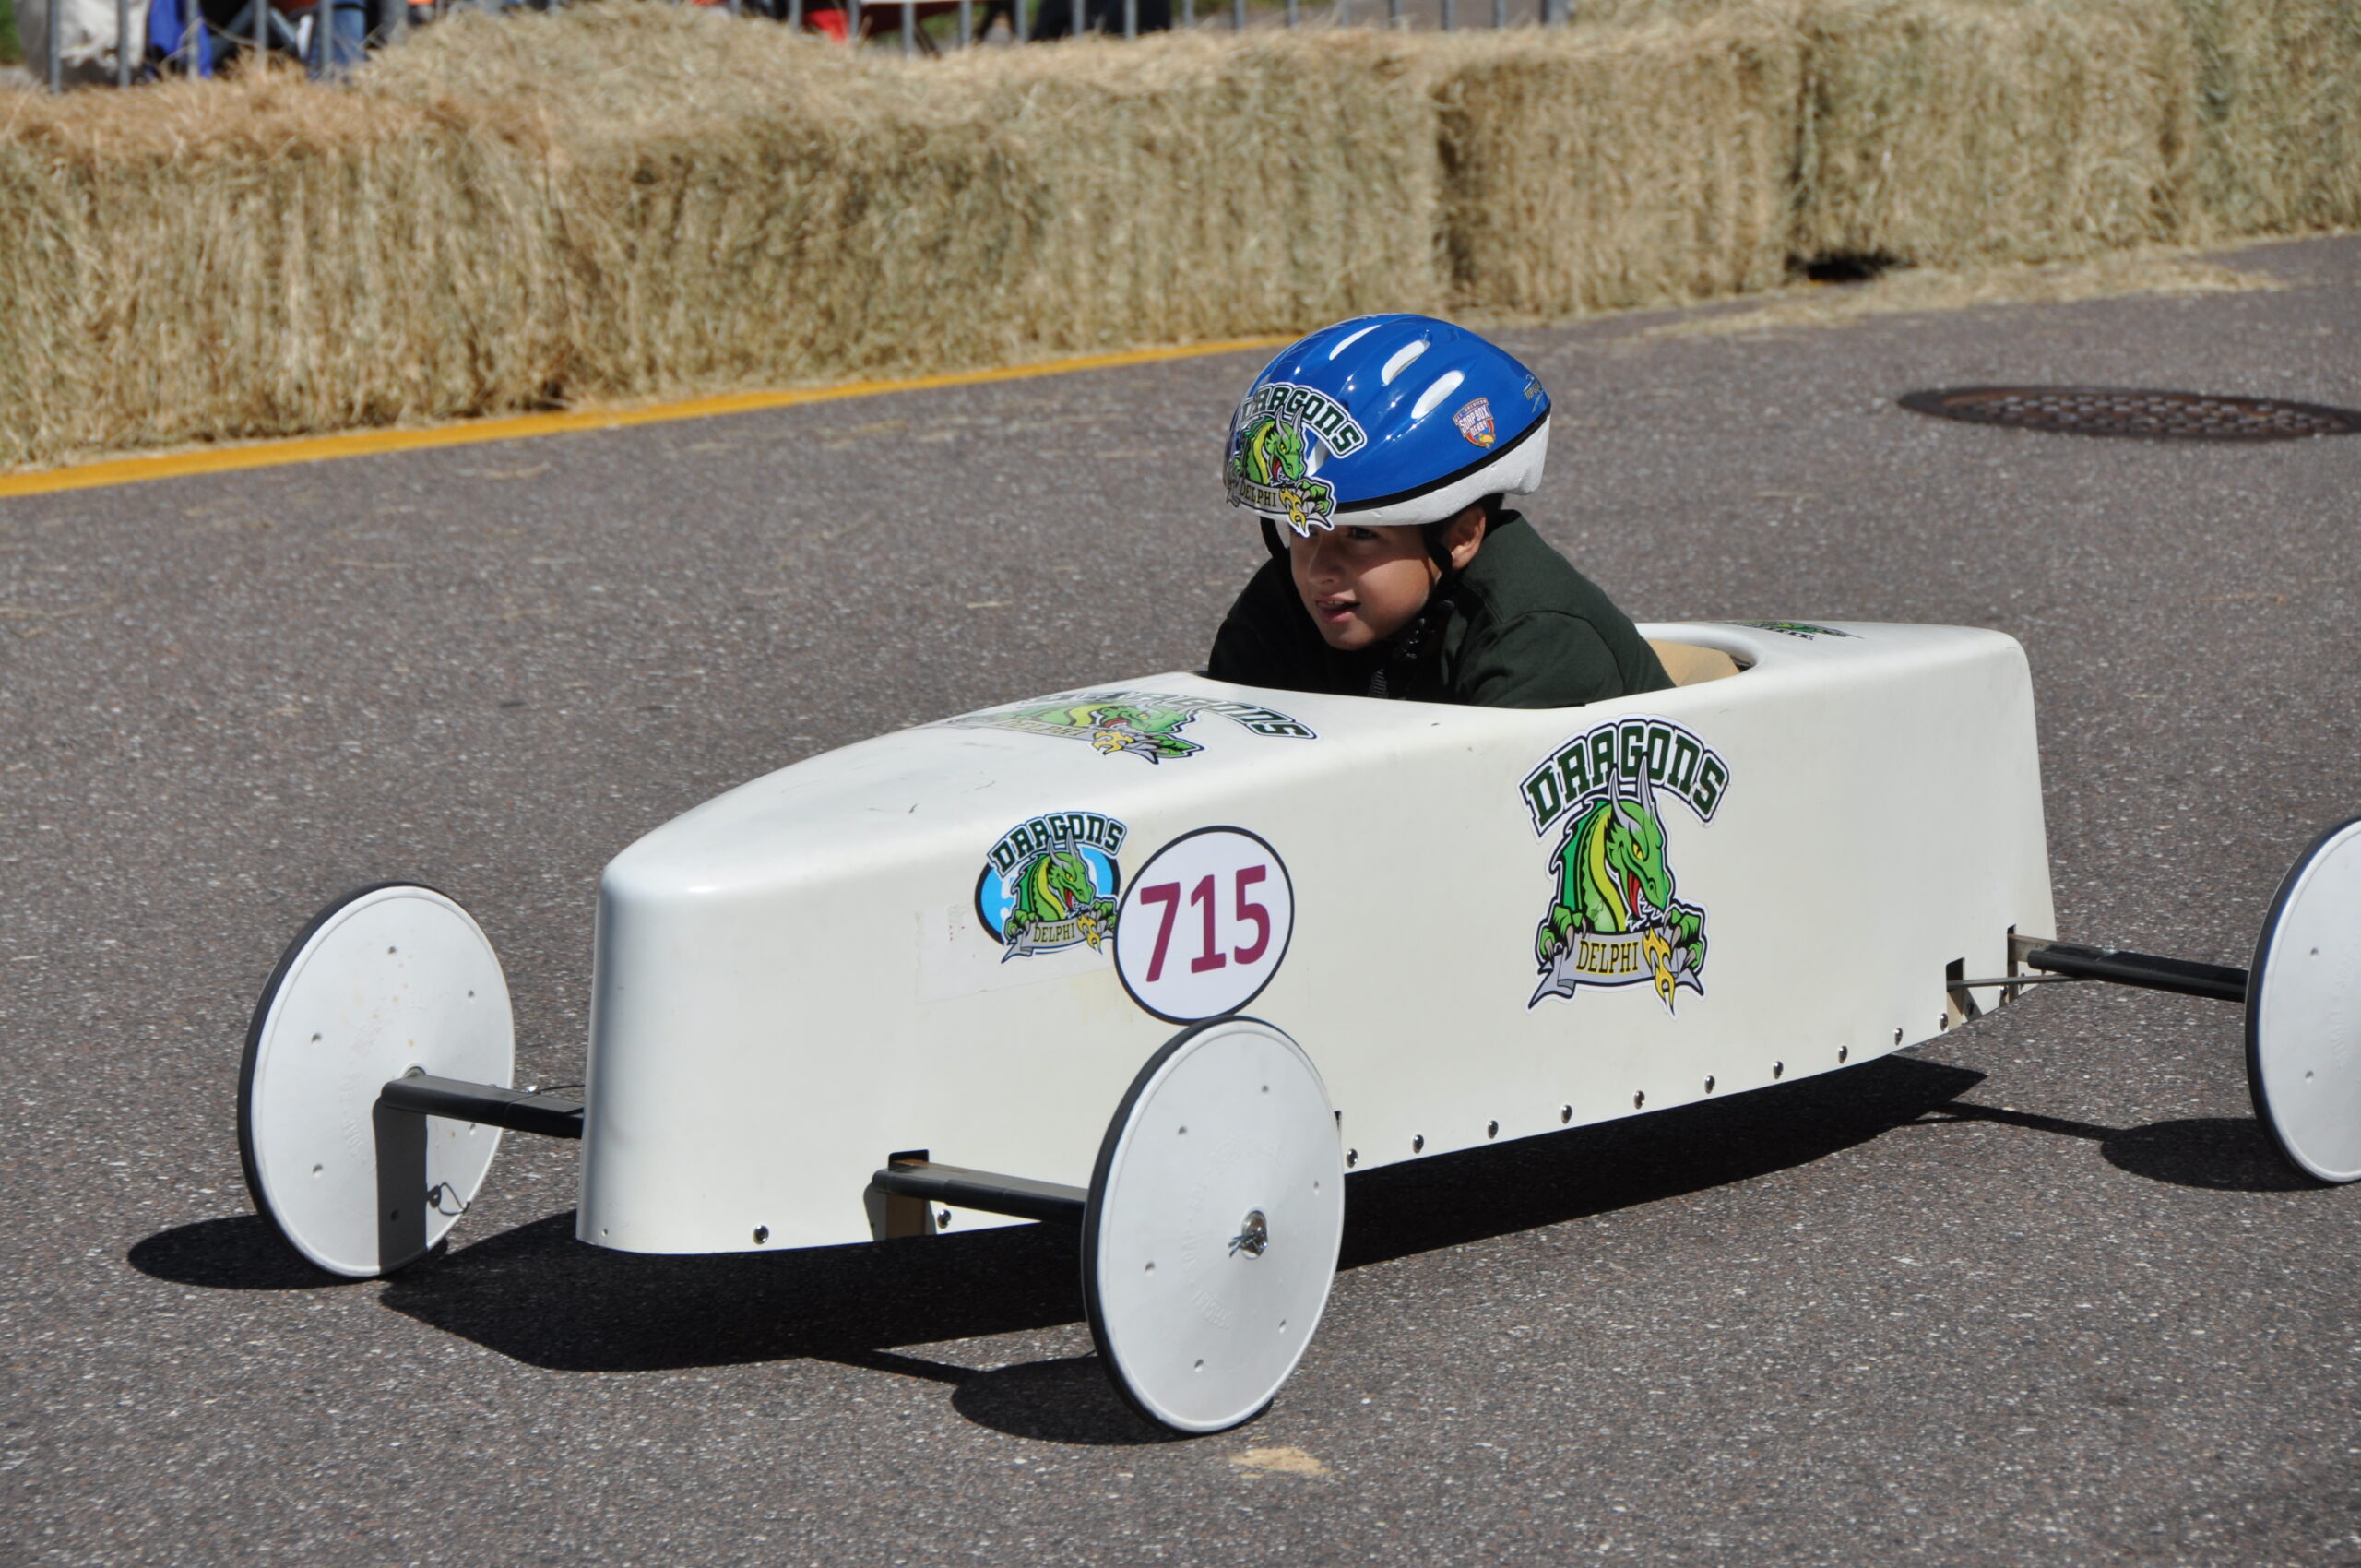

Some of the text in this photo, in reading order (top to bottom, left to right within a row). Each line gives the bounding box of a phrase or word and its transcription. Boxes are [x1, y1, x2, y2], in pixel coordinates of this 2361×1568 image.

[1459, 404, 1490, 434] SOAP BOX
[1240, 481, 1276, 507] DELPHI
[1526, 725, 1726, 827] DRAGONS
[991, 814, 1124, 873] DRAGONS
[1032, 922, 1076, 943] DELPHI
[1140, 864, 1271, 983] 715
[1576, 940, 1639, 973] DELPHI
